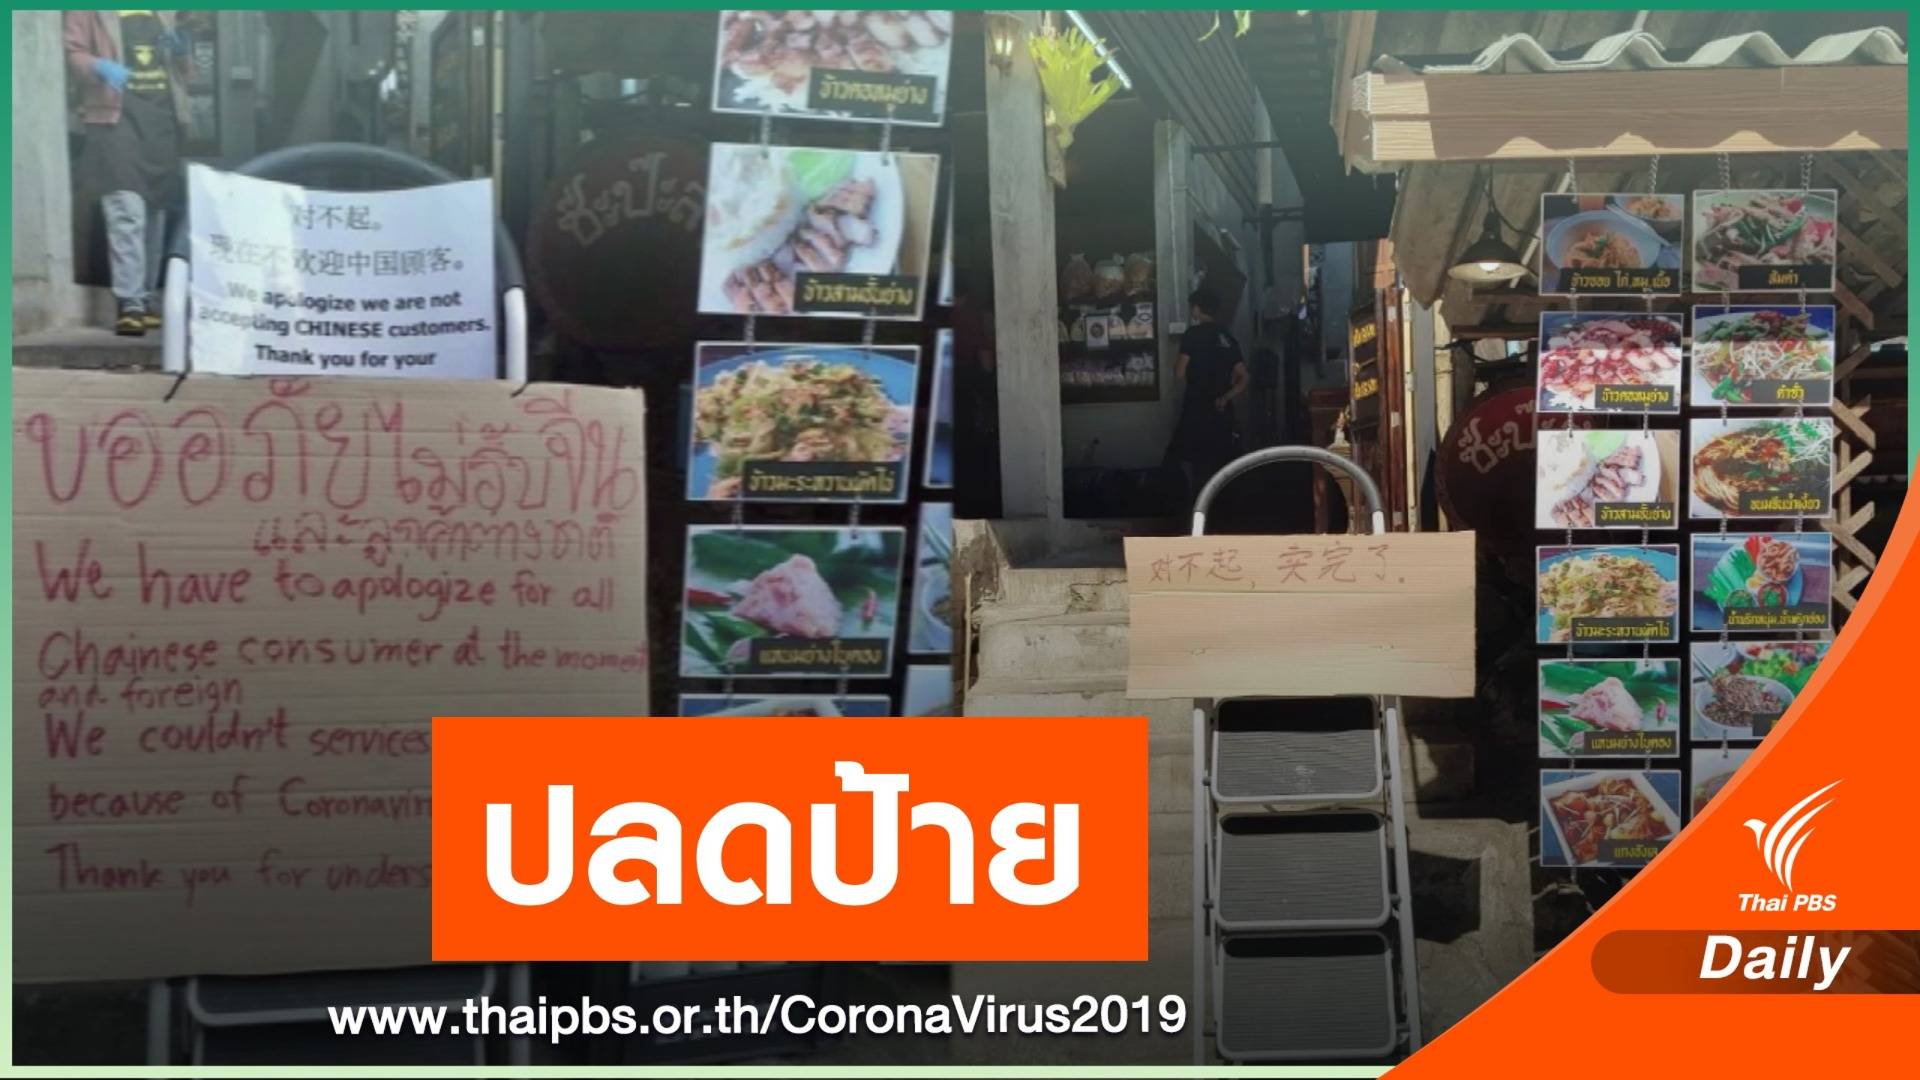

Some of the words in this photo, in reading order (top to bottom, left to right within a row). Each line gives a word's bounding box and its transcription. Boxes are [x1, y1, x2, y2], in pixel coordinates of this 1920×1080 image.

[227, 281, 259, 302] We
[262, 289, 363, 314] apologize
[362, 297, 389, 311] we
[394, 295, 425, 311] are
[430, 290, 461, 308] not
[199, 305, 290, 337] accepting
[295, 318, 383, 339] CHINESE
[388, 317, 491, 338] customers.
[254, 344, 315, 366] Thank
[319, 353, 354, 370] you
[360, 351, 388, 367] for
[394, 352, 437, 370] your
[34, 538, 114, 603] We
[137, 541, 252, 610] have
[273, 558, 325, 601] to
[332, 564, 497, 623] apologize
[513, 569, 553, 608] for
[572, 576, 615, 613] all
[238, 635, 444, 668] consumer
[453, 626, 486, 667] at
[498, 629, 547, 670] the
[120, 675, 243, 714] foreign
[45, 708, 107, 759] We
[139, 708, 290, 754] couldn't
[49, 781, 186, 821] because
[211, 774, 251, 815] of
[44, 842, 164, 893] Thank
[180, 864, 231, 908] you
[255, 847, 312, 890] for
